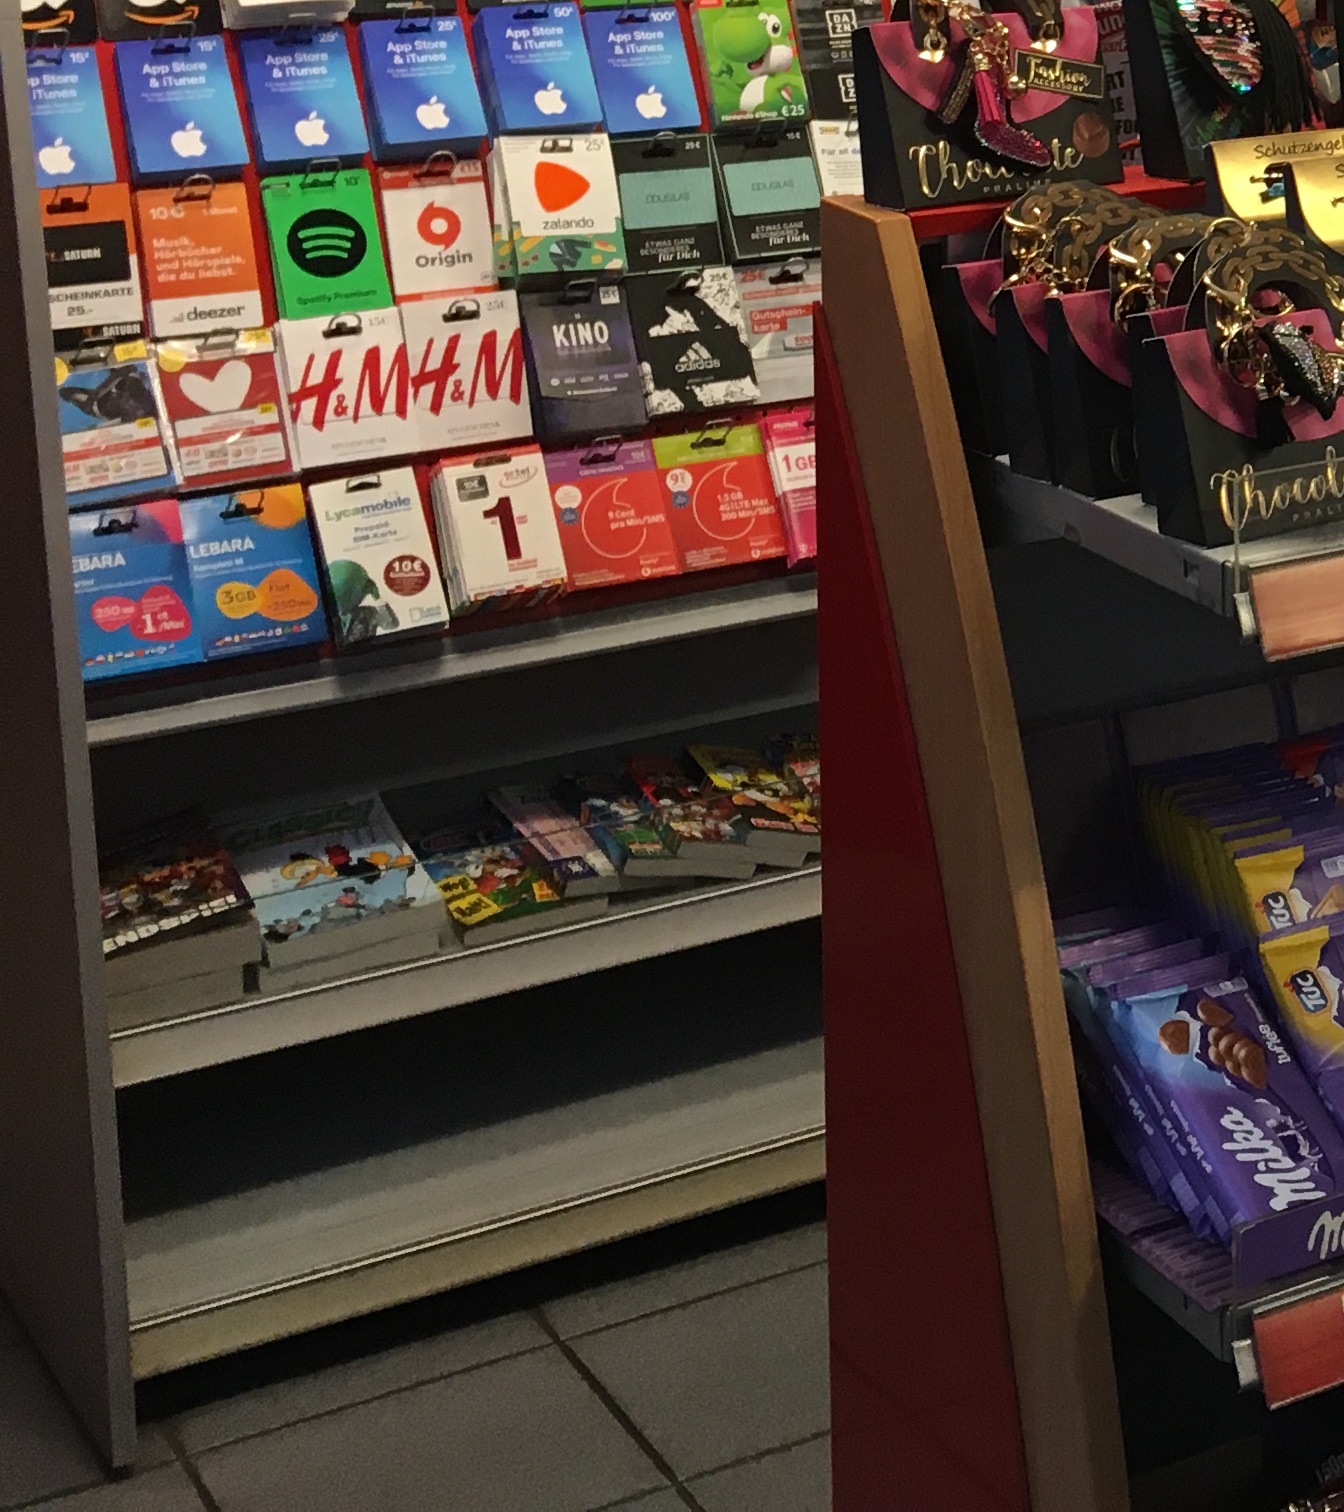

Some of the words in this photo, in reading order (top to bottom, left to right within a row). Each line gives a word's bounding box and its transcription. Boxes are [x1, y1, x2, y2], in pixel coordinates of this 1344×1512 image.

[505, 27, 529, 40] App
[532, 25, 564, 37] Store
[524, 37, 562, 51] iTunes
[142, 63, 168, 77] App
[172, 61, 207, 74] Store
[1025, 55, 1093, 88] Fashion
[162, 74, 206, 88] iTunes
[542, 216, 595, 233] zalando
[63, 247, 102, 261] SATURN
[415, 250, 473, 270] Origin
[658, 251, 674, 265] für
[676, 250, 700, 262] Dich
[186, 304, 246, 321] deezer
[553, 320, 610, 348] KINO
[411, 328, 524, 418] H&M
[674, 357, 721, 373] adidas
[288, 342, 408, 433] H&M
[325, 493, 412, 523] Lycamobile
[189, 536, 256, 559] LEBARA
[392, 560, 423, 574] 10€
